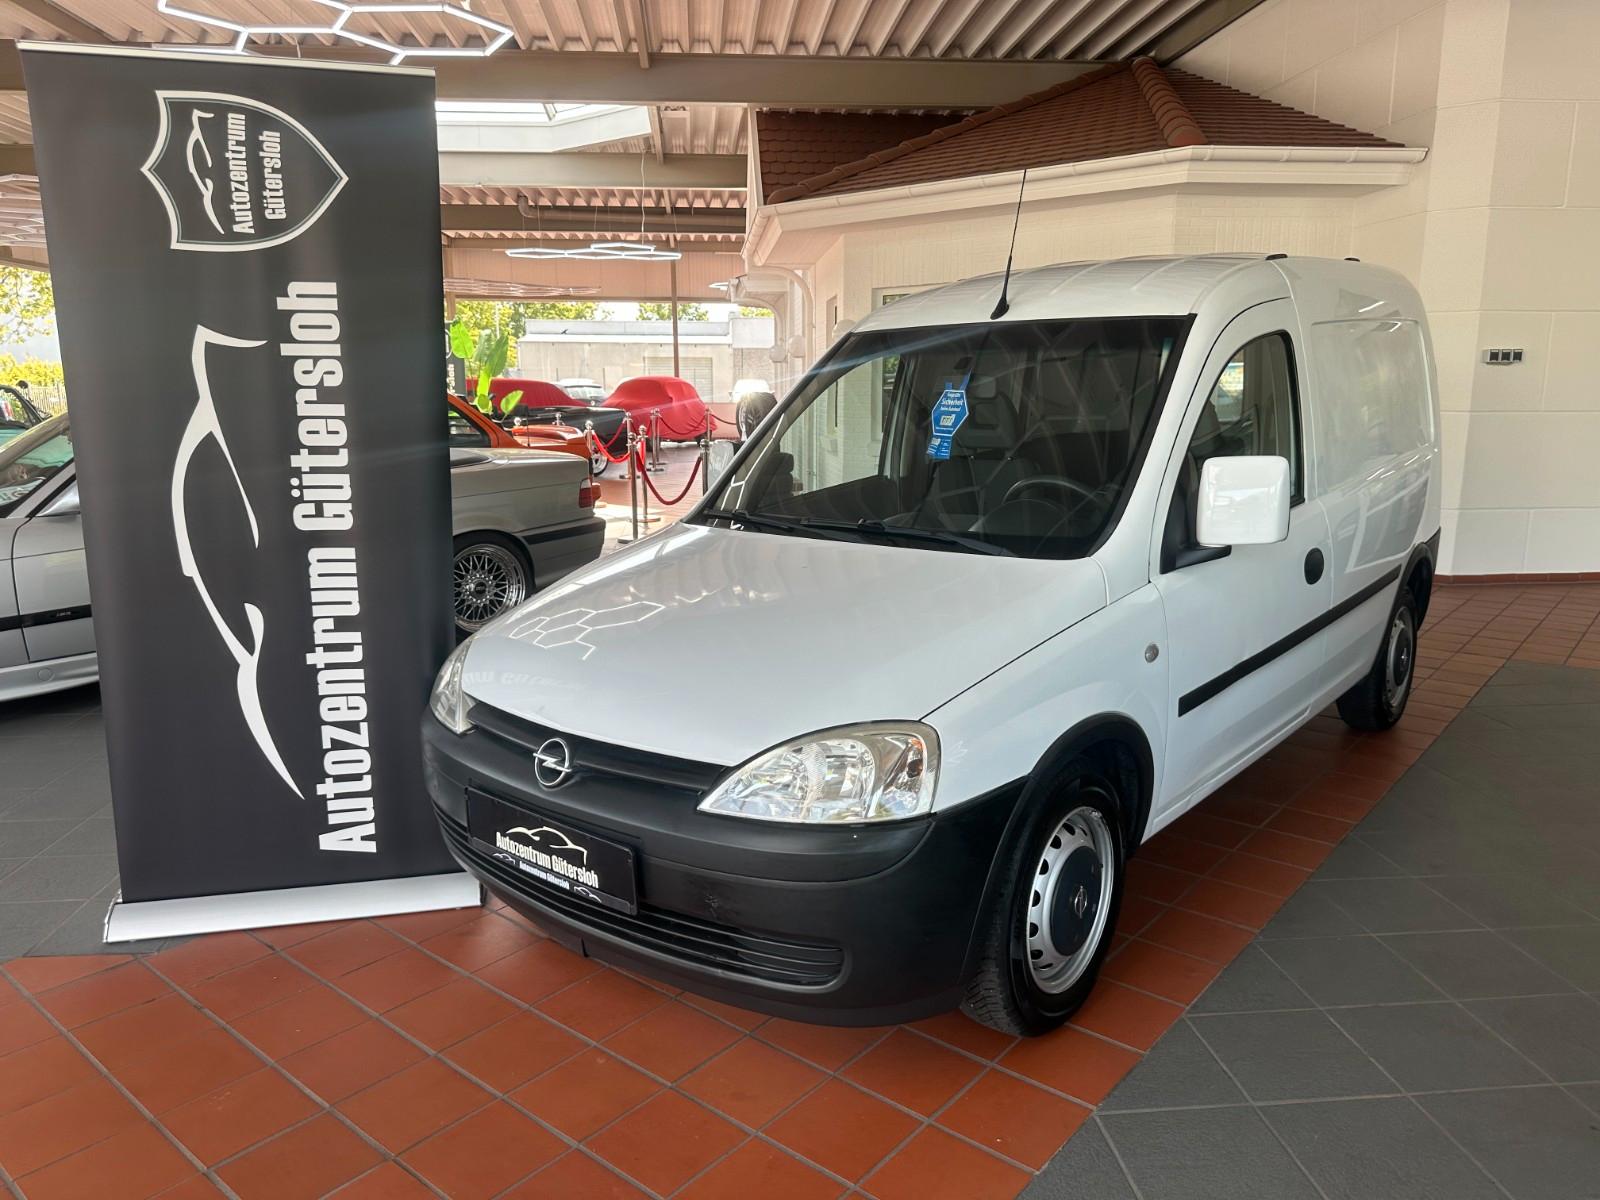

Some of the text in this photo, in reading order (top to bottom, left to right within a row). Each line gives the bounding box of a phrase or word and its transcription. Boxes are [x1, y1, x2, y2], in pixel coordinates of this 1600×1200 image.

[225, 112, 256, 234] Autozentrum
[258, 130, 287, 220] Gütersloh
[275, 281, 377, 853] Autozentrum Gütersloh
[496, 831, 599, 889] Autozentrum Gütersloh
[519, 860, 570, 890] Autozentrum Gütersloh
